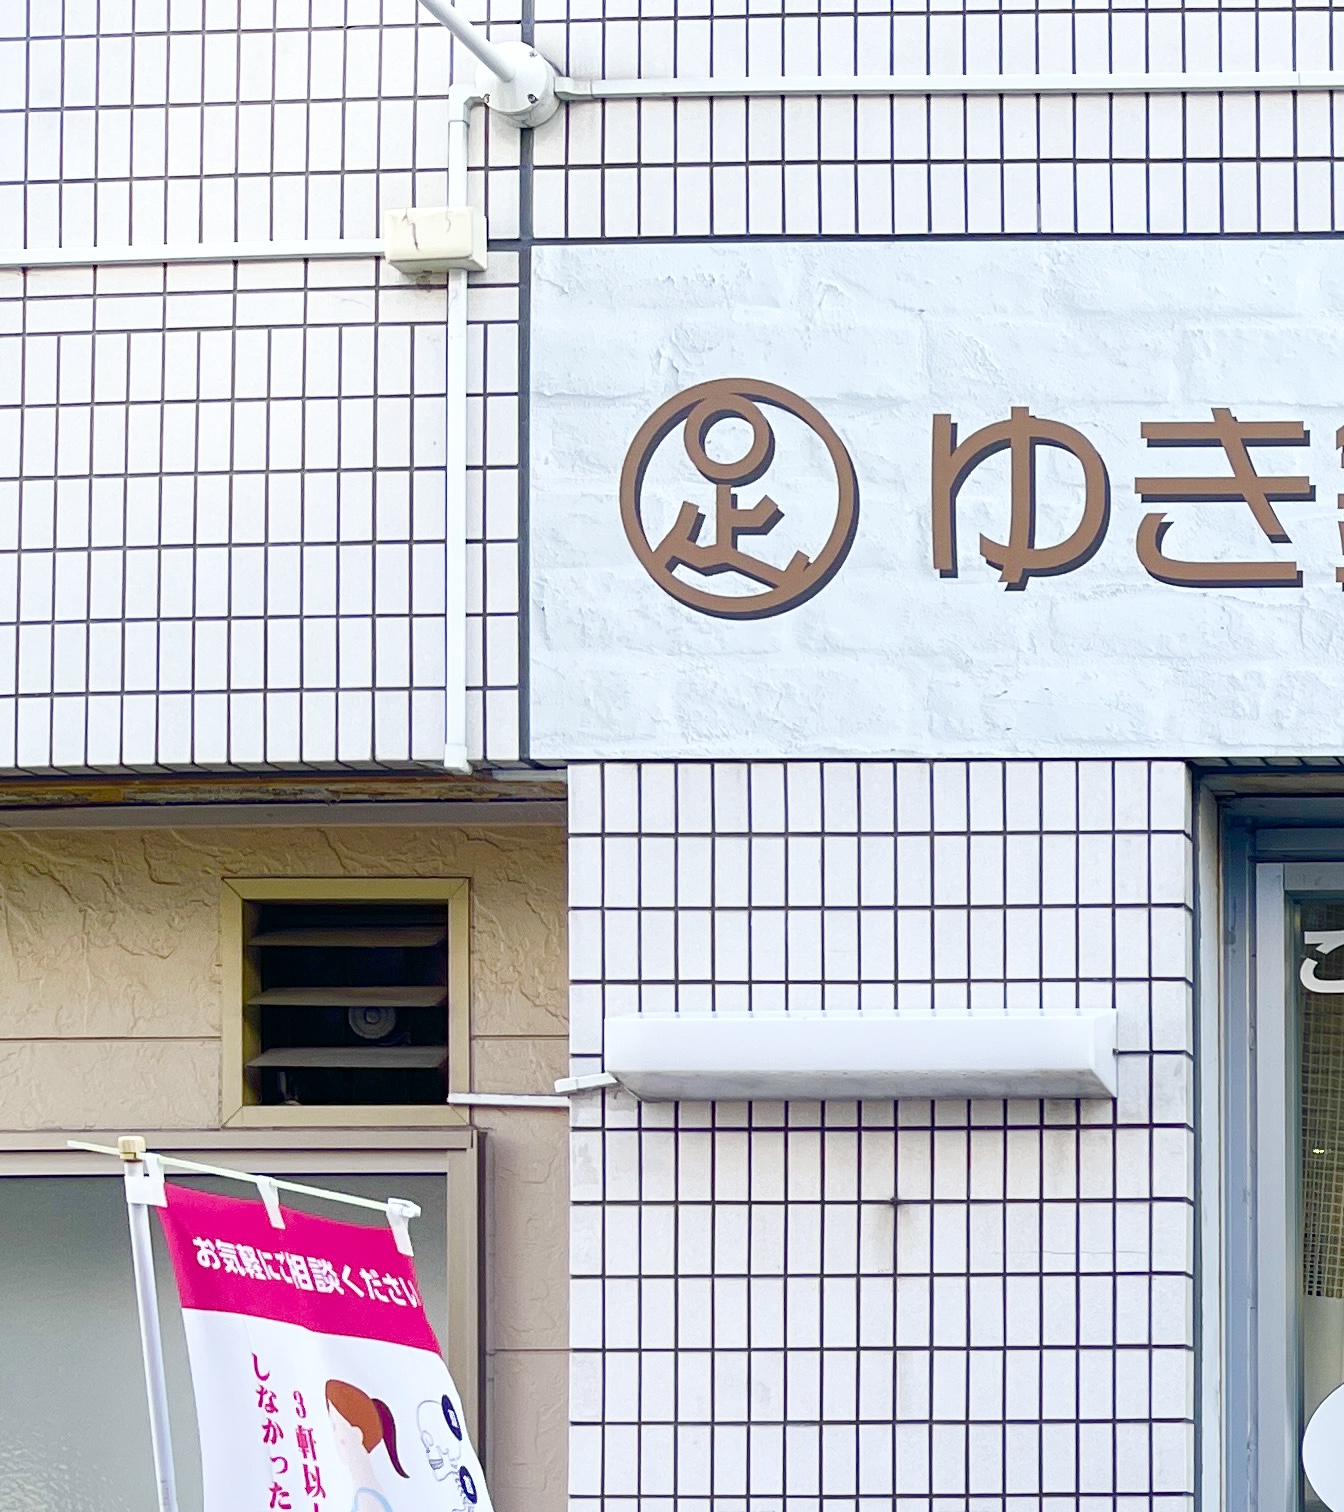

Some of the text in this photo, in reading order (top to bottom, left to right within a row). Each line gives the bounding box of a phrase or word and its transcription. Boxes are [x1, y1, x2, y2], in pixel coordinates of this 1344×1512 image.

[192, 1236, 421, 1308] お気軽にご相談ください
